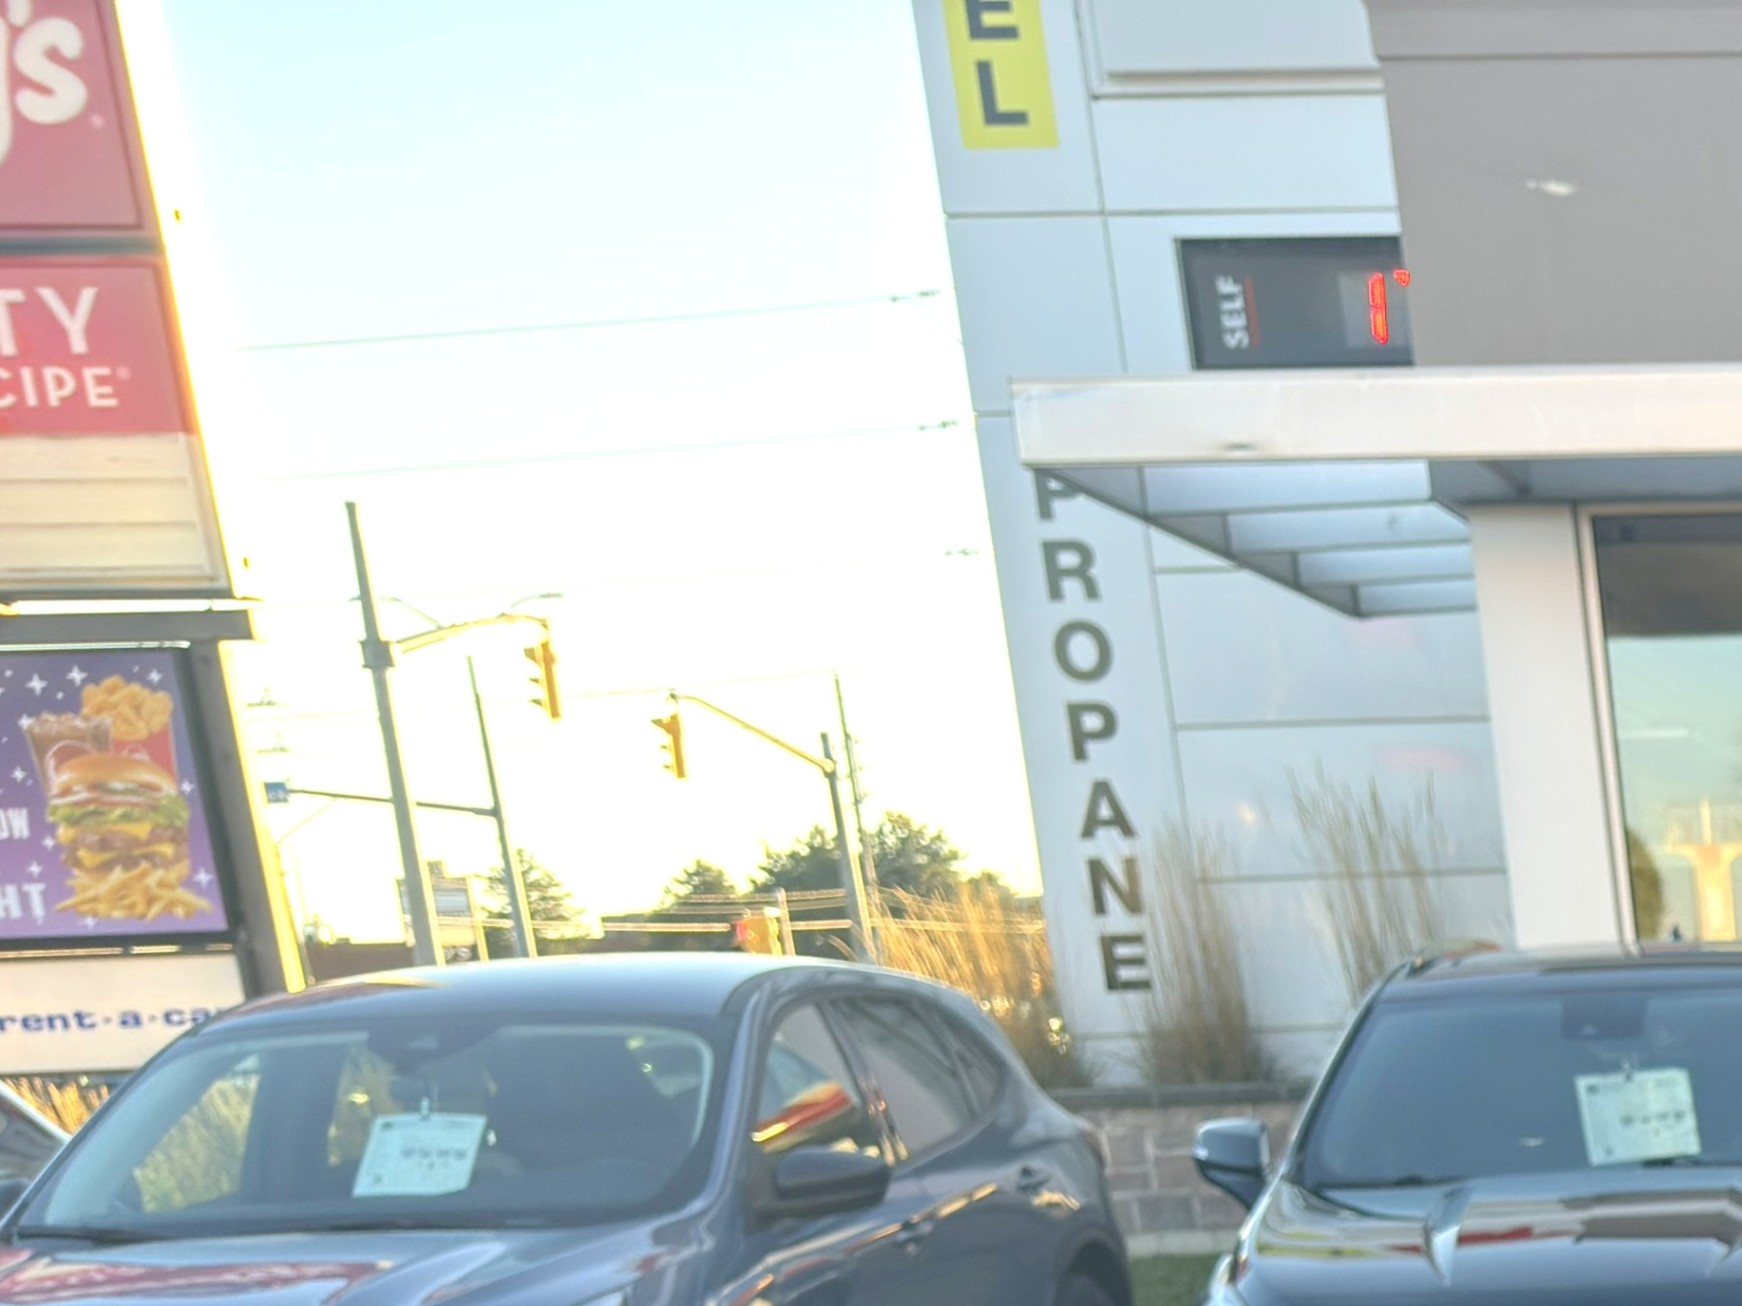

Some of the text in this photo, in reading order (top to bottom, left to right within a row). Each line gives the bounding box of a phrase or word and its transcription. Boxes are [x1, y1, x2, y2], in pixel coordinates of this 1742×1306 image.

[965, 0, 1028, 125] EL
[1215, 274, 1249, 349] SELF
[1034, 470, 1151, 991] PROPANE
